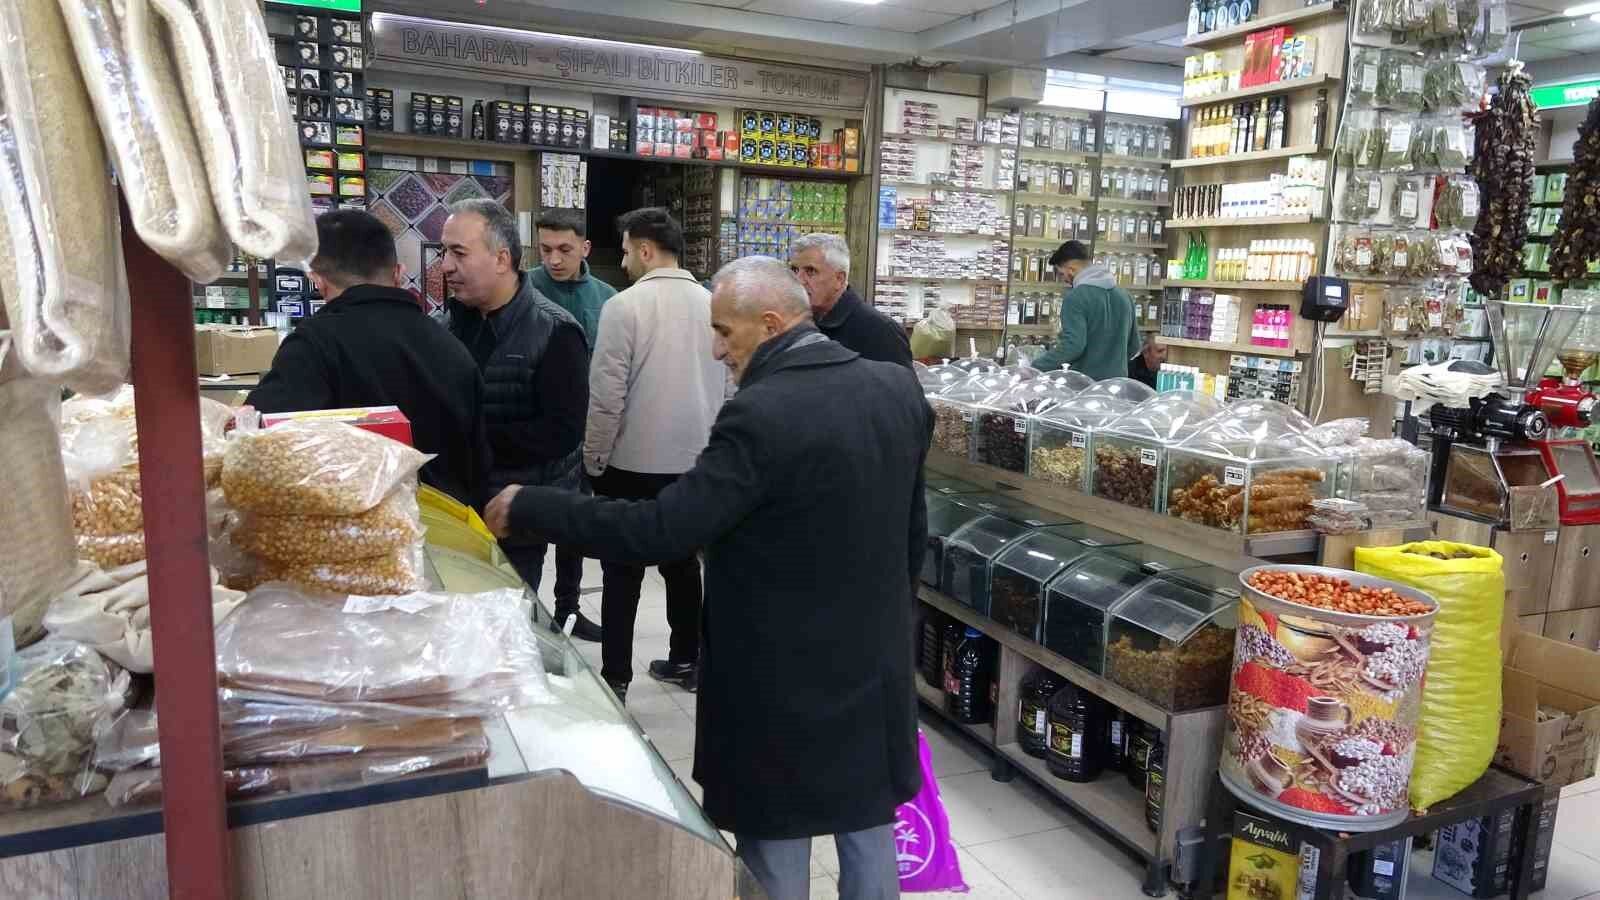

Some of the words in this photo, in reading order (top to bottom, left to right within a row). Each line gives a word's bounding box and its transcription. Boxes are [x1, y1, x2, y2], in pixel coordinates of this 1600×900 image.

[400, 28, 534, 66] BAHARAT
[638, 52, 738, 89] BİTKİLER
[758, 70, 841, 103] TOHUM
